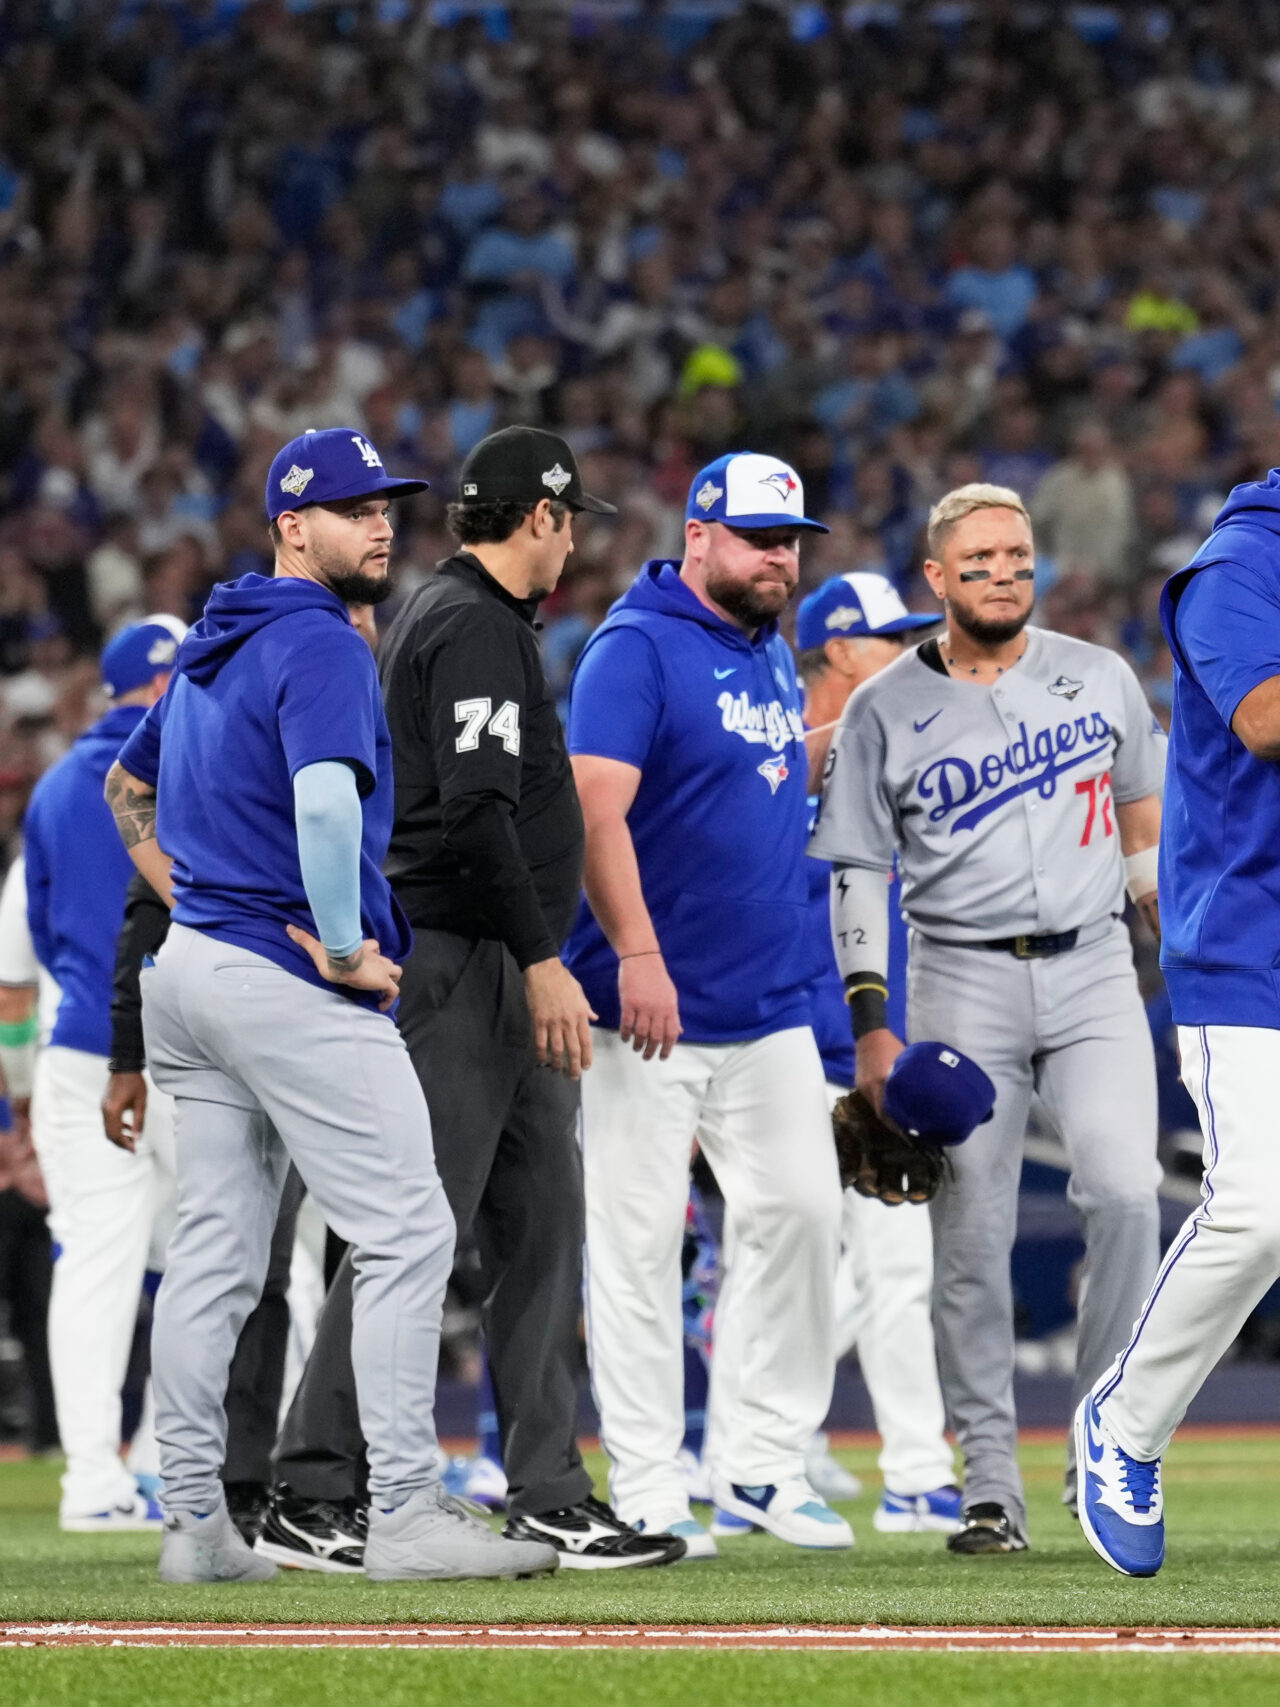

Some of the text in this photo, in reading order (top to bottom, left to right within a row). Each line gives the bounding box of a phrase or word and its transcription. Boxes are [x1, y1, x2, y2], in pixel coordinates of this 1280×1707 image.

[351, 436, 383, 468] LA
[454, 697, 521, 757] 74
[917, 711, 1114, 823] Dodgers
